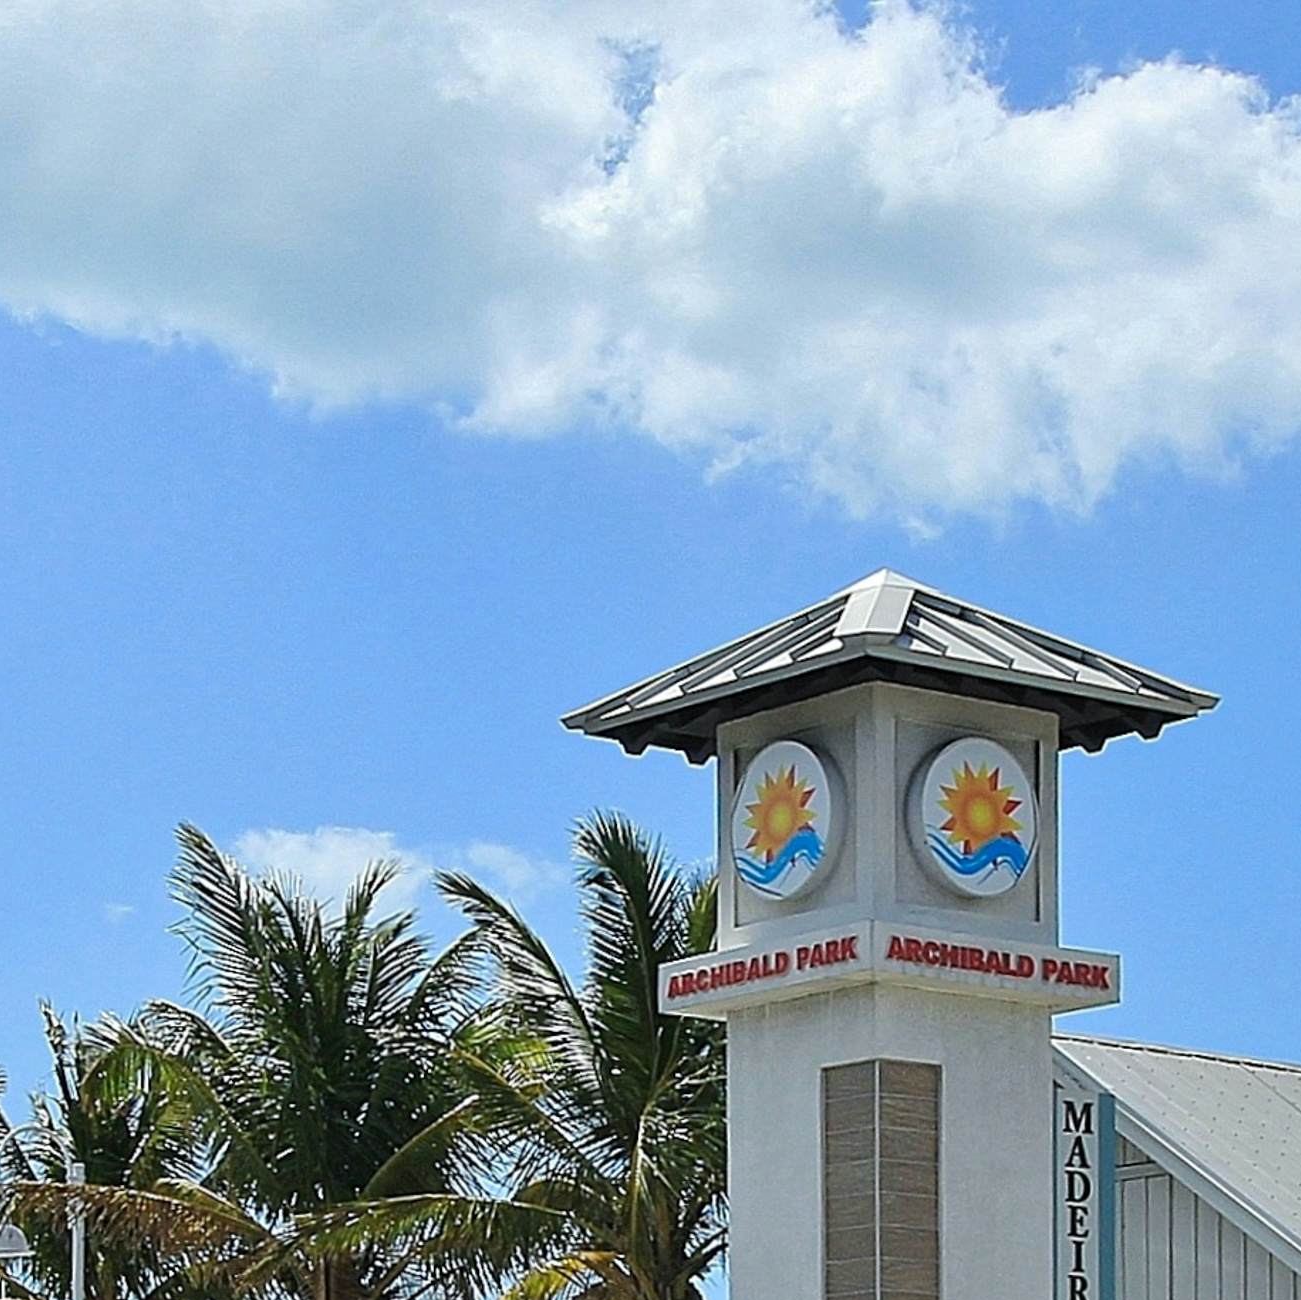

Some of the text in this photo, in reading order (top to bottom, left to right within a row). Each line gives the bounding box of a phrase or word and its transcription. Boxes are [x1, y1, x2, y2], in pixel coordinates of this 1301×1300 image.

[667, 935, 859, 999] ARCHIBALD PARK
[885, 935, 1110, 990] ARCHIBALD PARK
